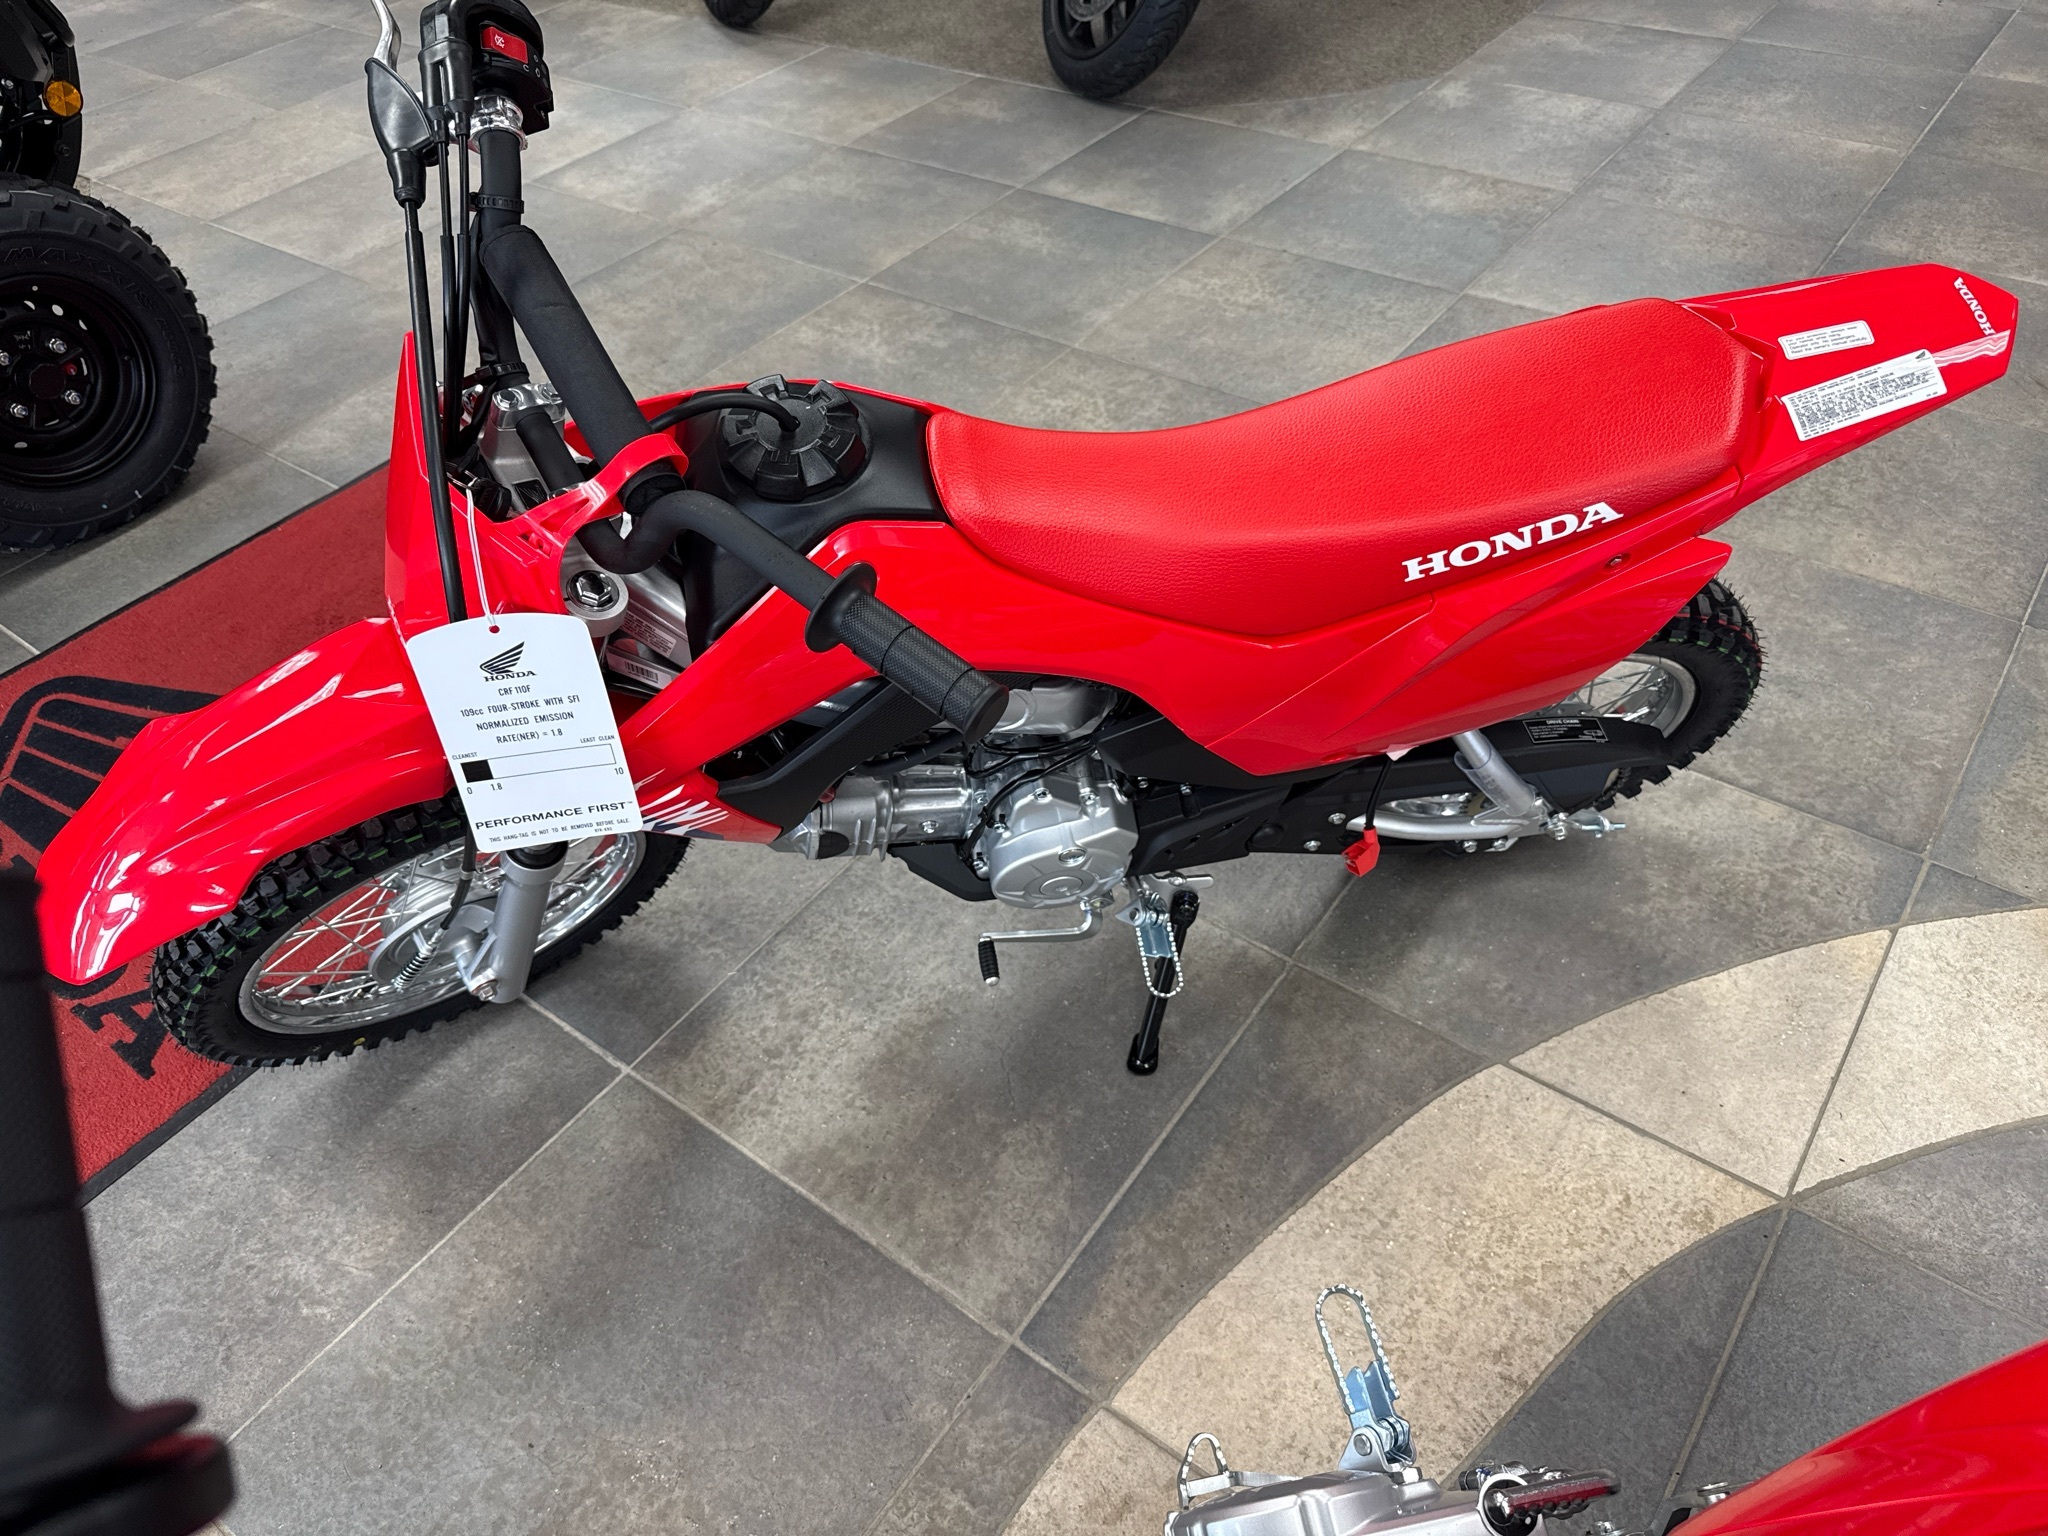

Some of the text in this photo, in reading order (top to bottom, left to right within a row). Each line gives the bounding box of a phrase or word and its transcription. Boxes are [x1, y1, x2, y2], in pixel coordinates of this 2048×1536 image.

[4, 247, 153, 312] MAXXIS
[1953, 276, 1997, 336] HONDA
[1401, 501, 1624, 583] HONDA
[484, 670, 537, 682] HONDA
[498, 684, 531, 697] CRF 110F
[460, 694, 580, 718] 109cc FOUR-STROKE WITH SFI
[475, 711, 575, 731] NORMALIZED EMISSION
[495, 730, 540, 744] RATE(NER)
[550, 728, 563, 737] 1.8
[452, 751, 478, 760] CLEANEST
[614, 767, 624, 776] 10
[466, 782, 503, 795] 0 1.8
[475, 807, 583, 830] PERFORMANCE
